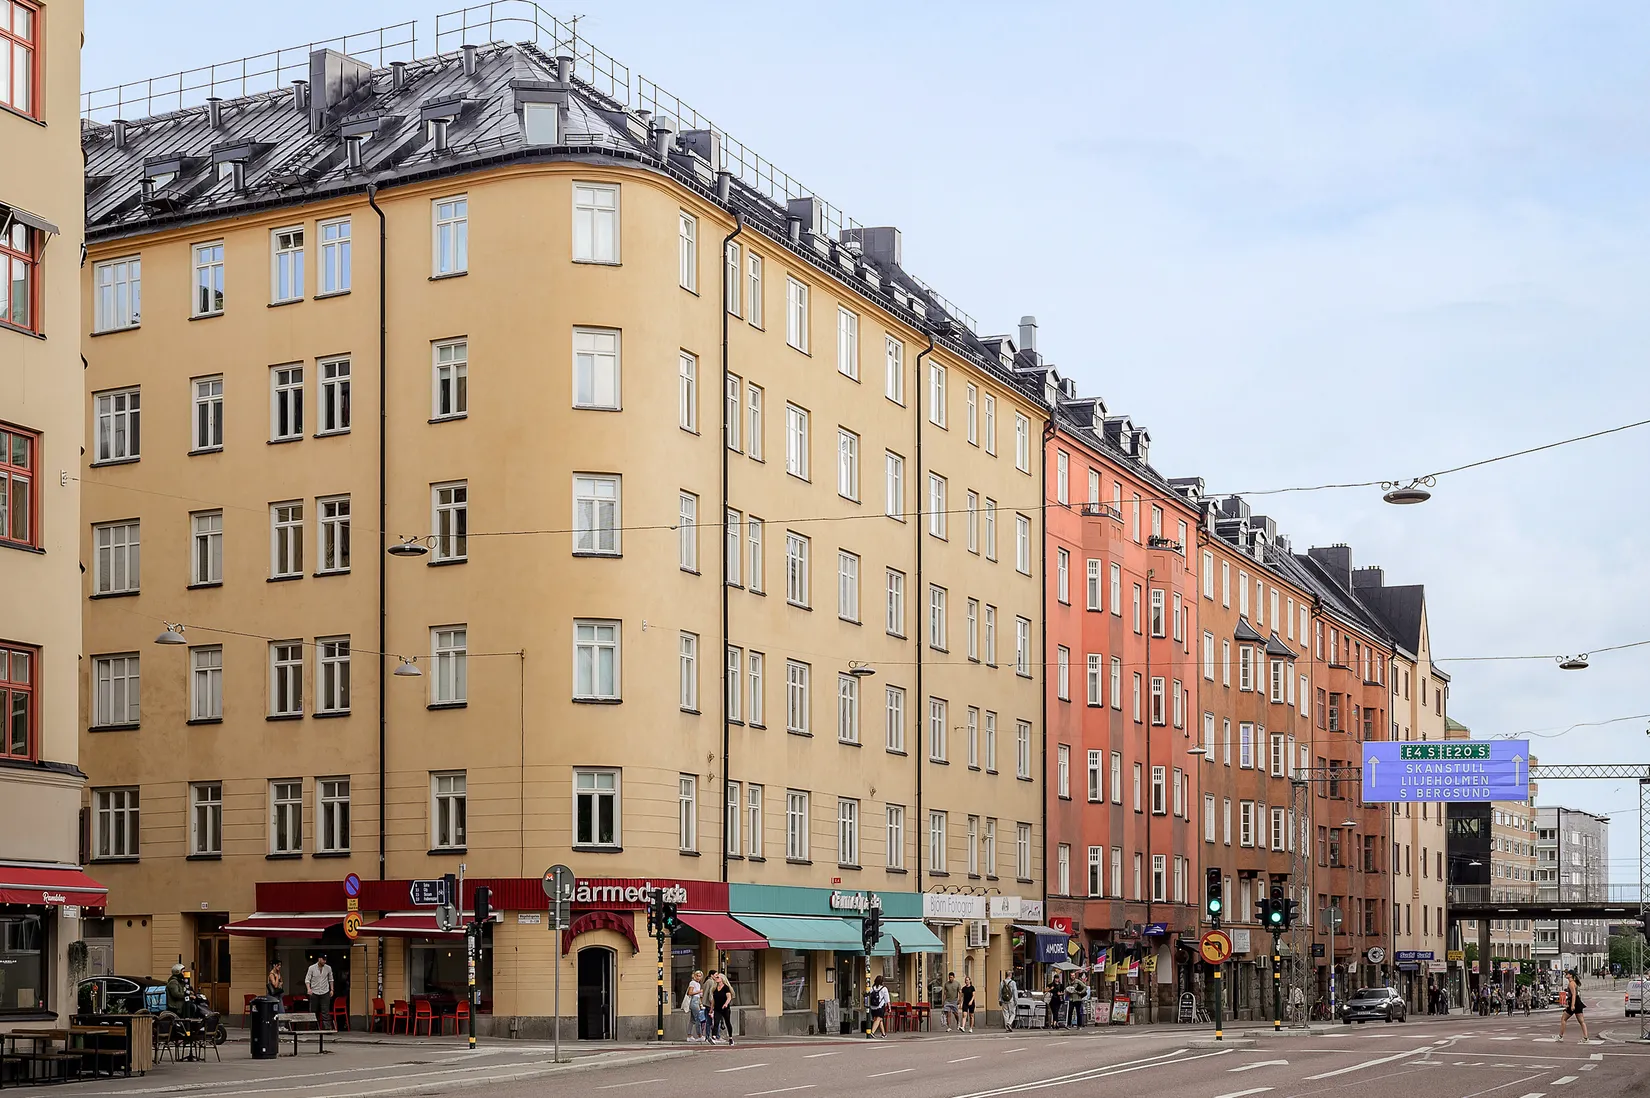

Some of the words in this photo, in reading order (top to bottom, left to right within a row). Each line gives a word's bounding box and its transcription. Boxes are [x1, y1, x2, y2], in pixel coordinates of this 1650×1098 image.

[1406, 748, 1422, 757] E4
[1428, 748, 1435, 757] S
[1446, 747, 1472, 757] E20
[1479, 747, 1486, 756] S
[1406, 763, 1485, 774] SKANSTULL
[1401, 775, 1489, 786] LILJEHOLMEN
[1400, 788, 1407, 798] S
[1416, 788, 1490, 798] BERGSUND
[42, 891, 66, 904] Ramblas
[930, 896, 947, 915] Björn
[948, 897, 974, 917] Fotograf
[347, 918, 360, 933] 30
[1045, 943, 1065, 954] AMORE
